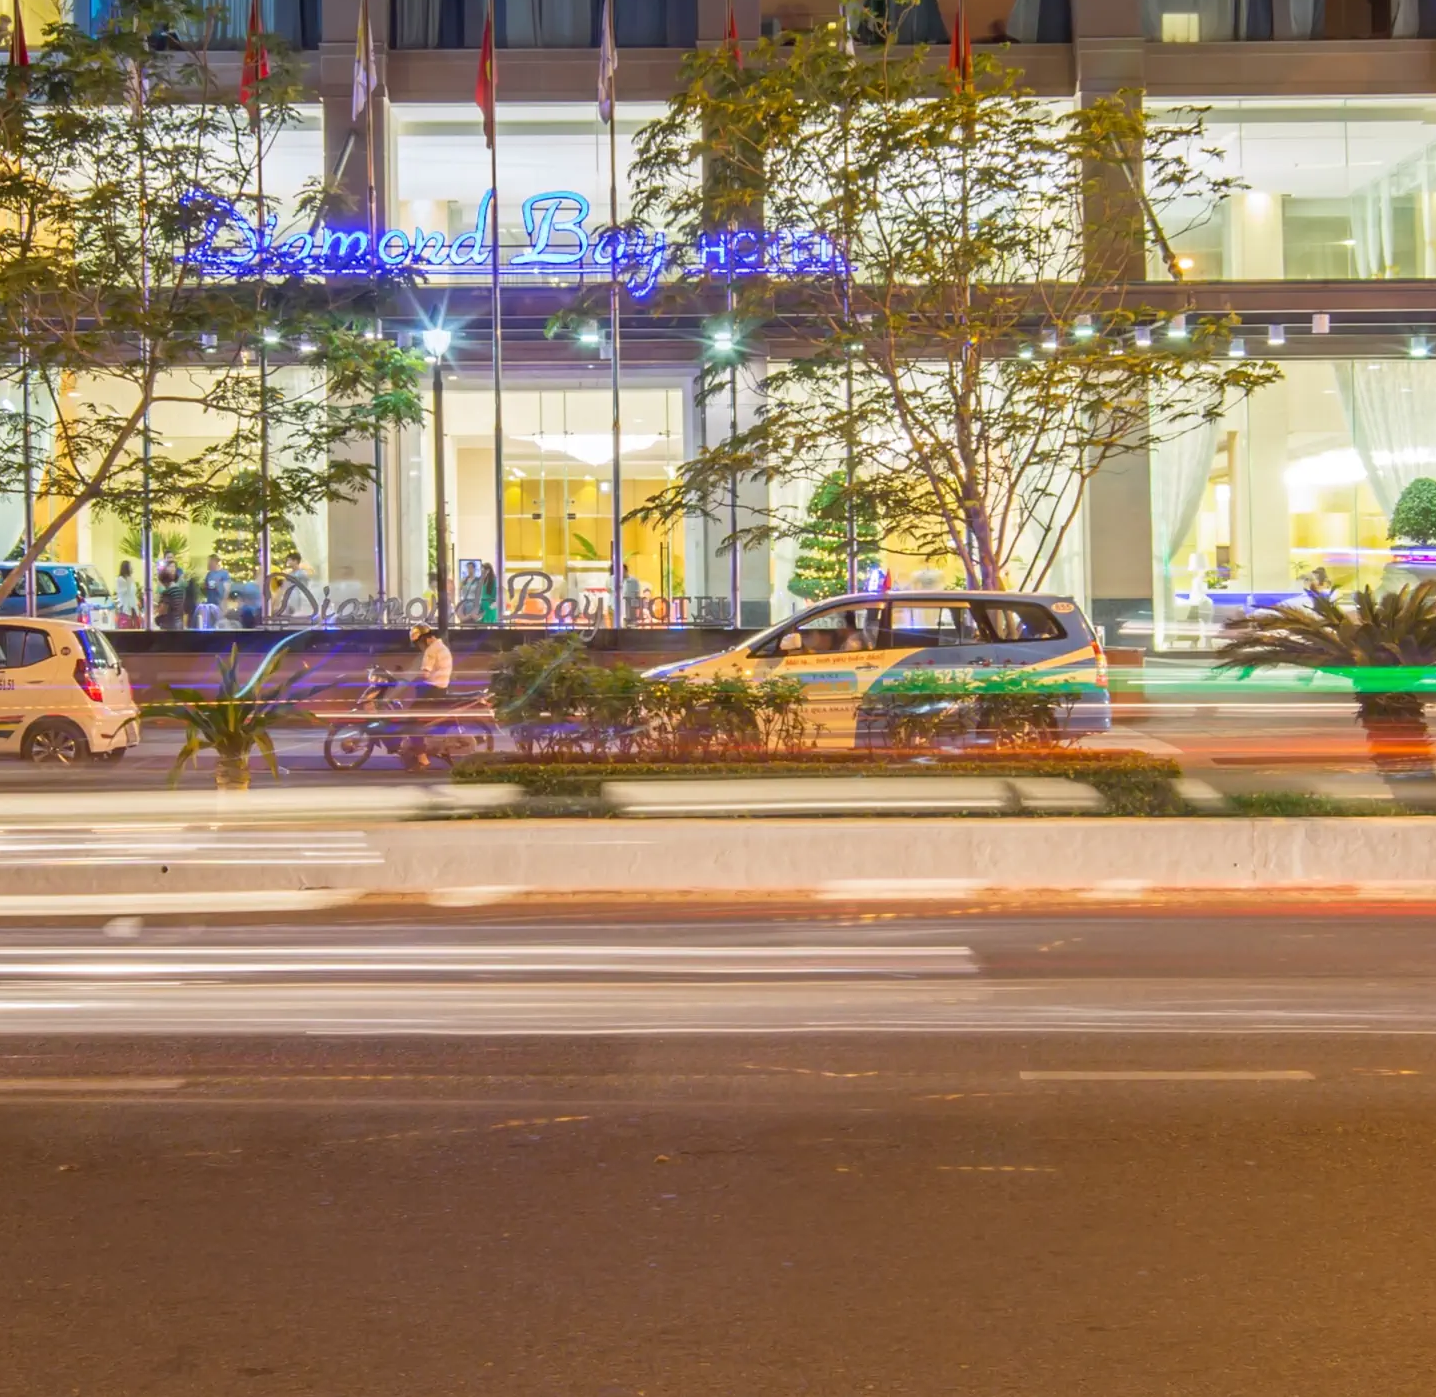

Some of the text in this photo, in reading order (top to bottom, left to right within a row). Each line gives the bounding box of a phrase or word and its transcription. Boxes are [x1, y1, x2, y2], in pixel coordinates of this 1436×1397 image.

[510, 189, 666, 299] Bay
[500, 570, 605, 642] Bay
[622, 595, 738, 623] HOTEL
